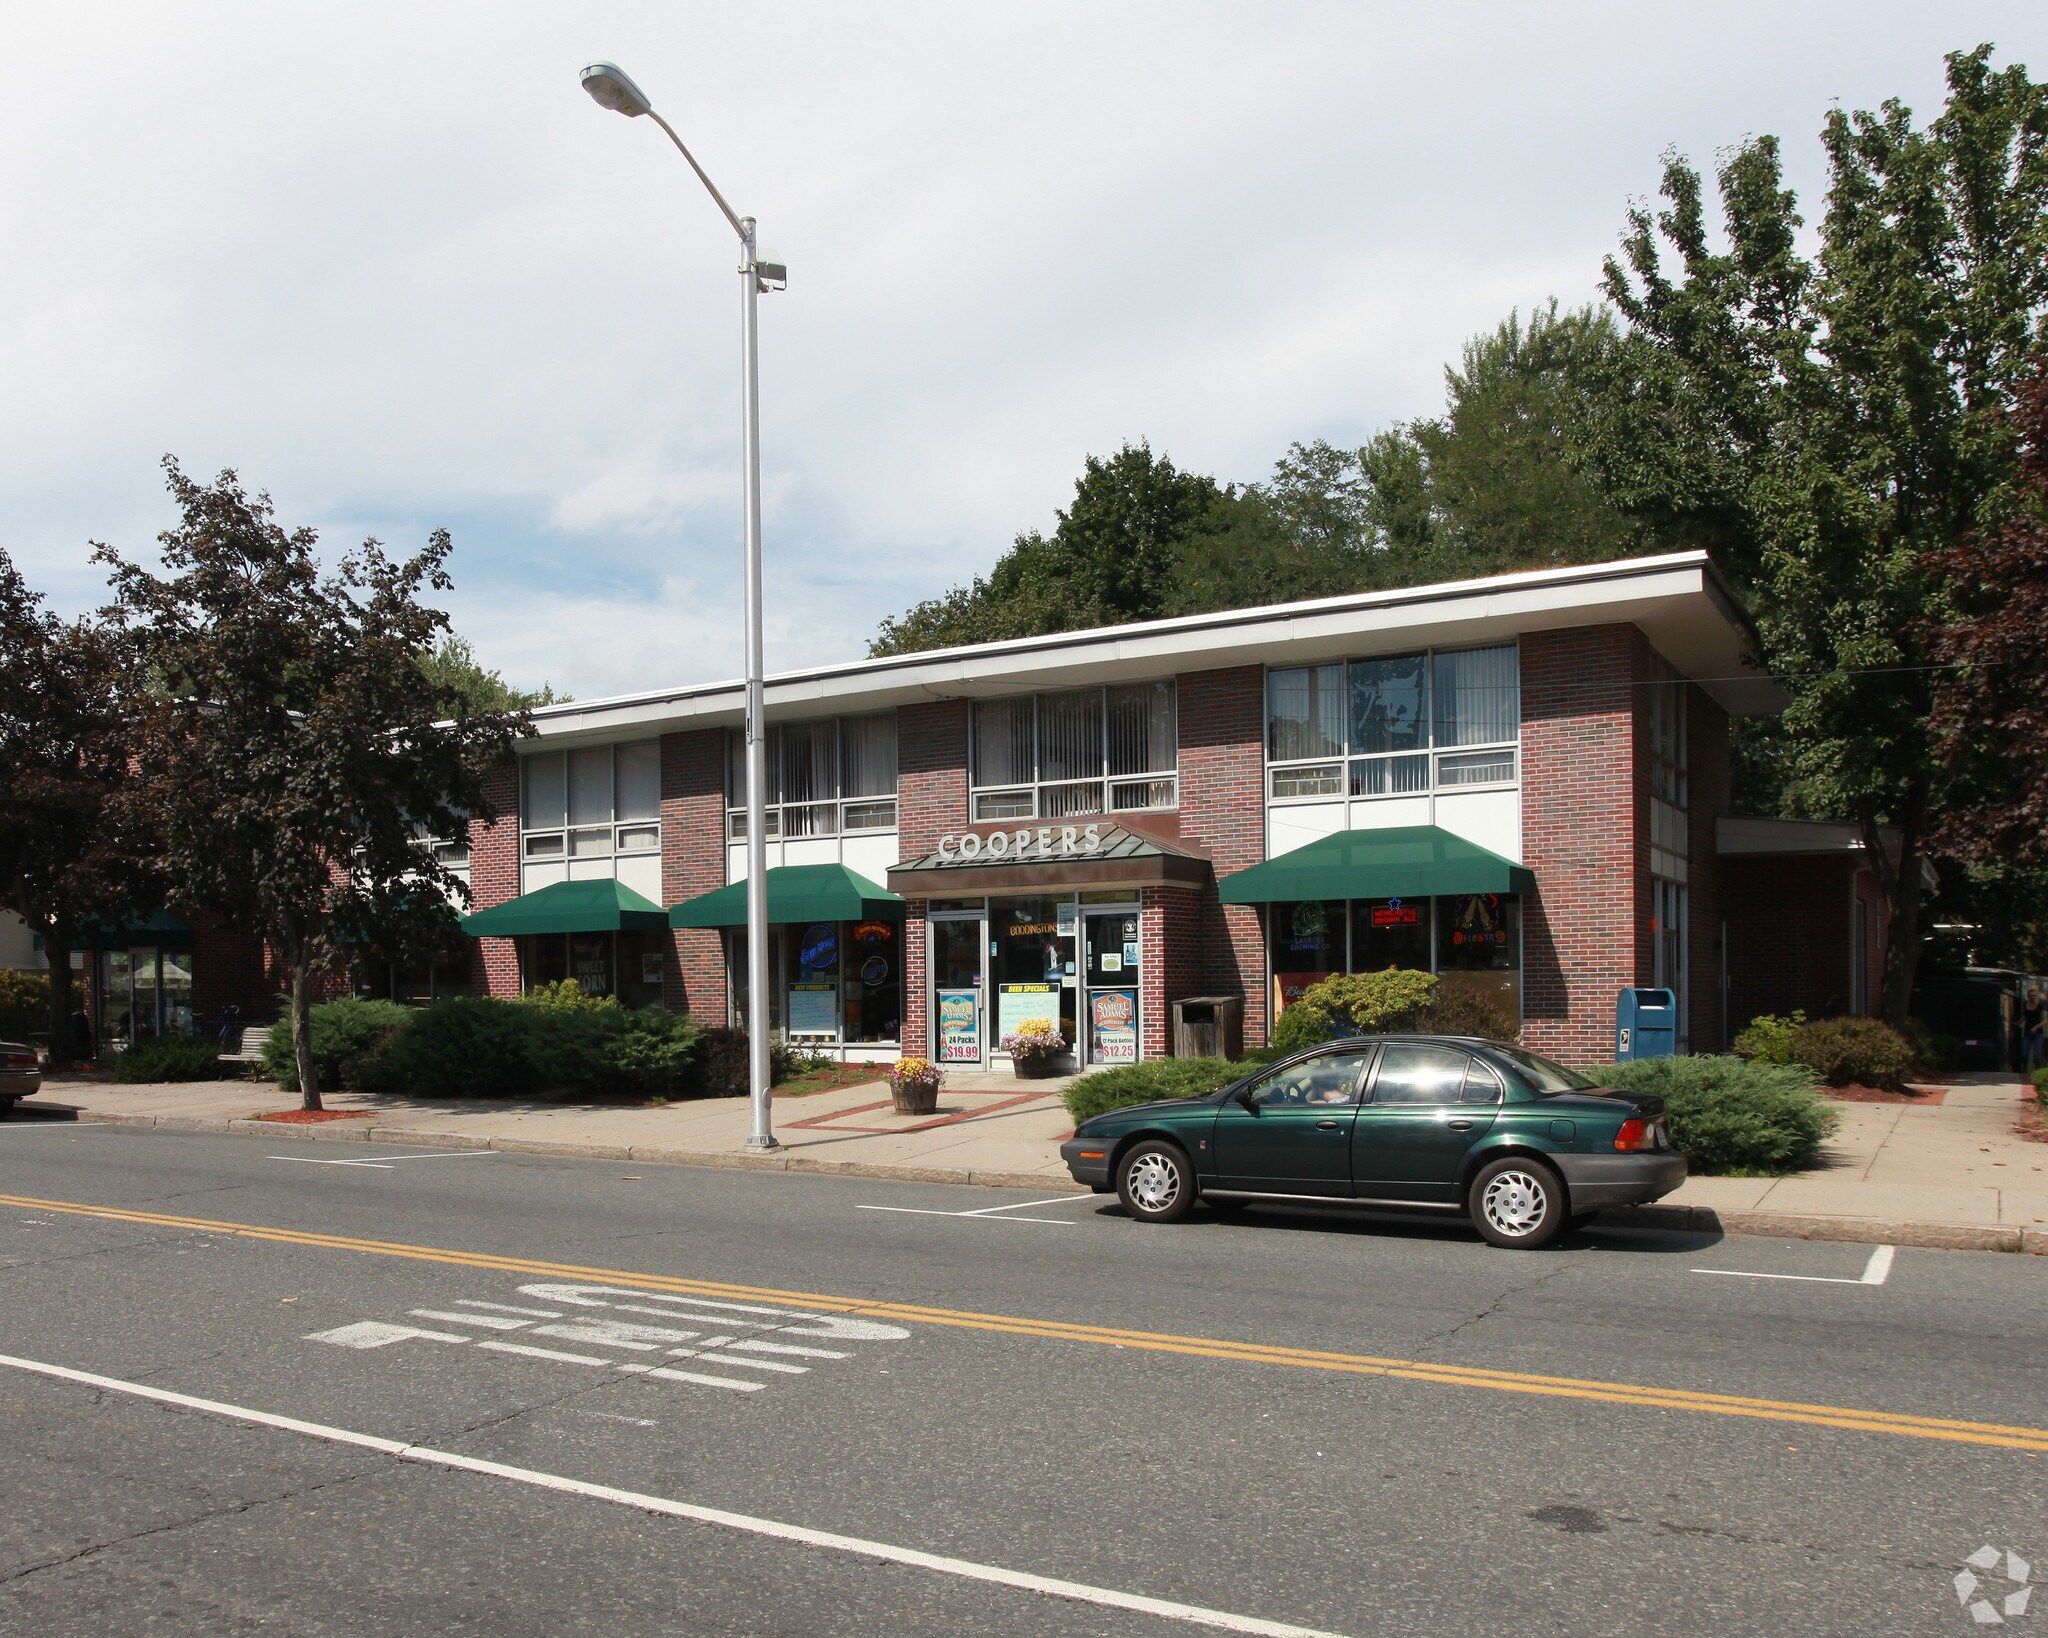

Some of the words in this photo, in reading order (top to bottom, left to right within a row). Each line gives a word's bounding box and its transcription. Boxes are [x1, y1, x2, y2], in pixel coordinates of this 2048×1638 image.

[938, 824, 1101, 859] COOPERS
[576, 960, 605, 974] SWEET
[1008, 985, 1022, 993] BEER
[943, 1004, 970, 1013] SAMUEL
[1096, 1001, 1130, 1013] SAMUEL
[1100, 1010, 1127, 1021] ADAMS
[957, 1036, 976, 1044] Packs
[947, 1045, 978, 1058] $19.99
[1103, 1045, 1134, 1057] $12.25
